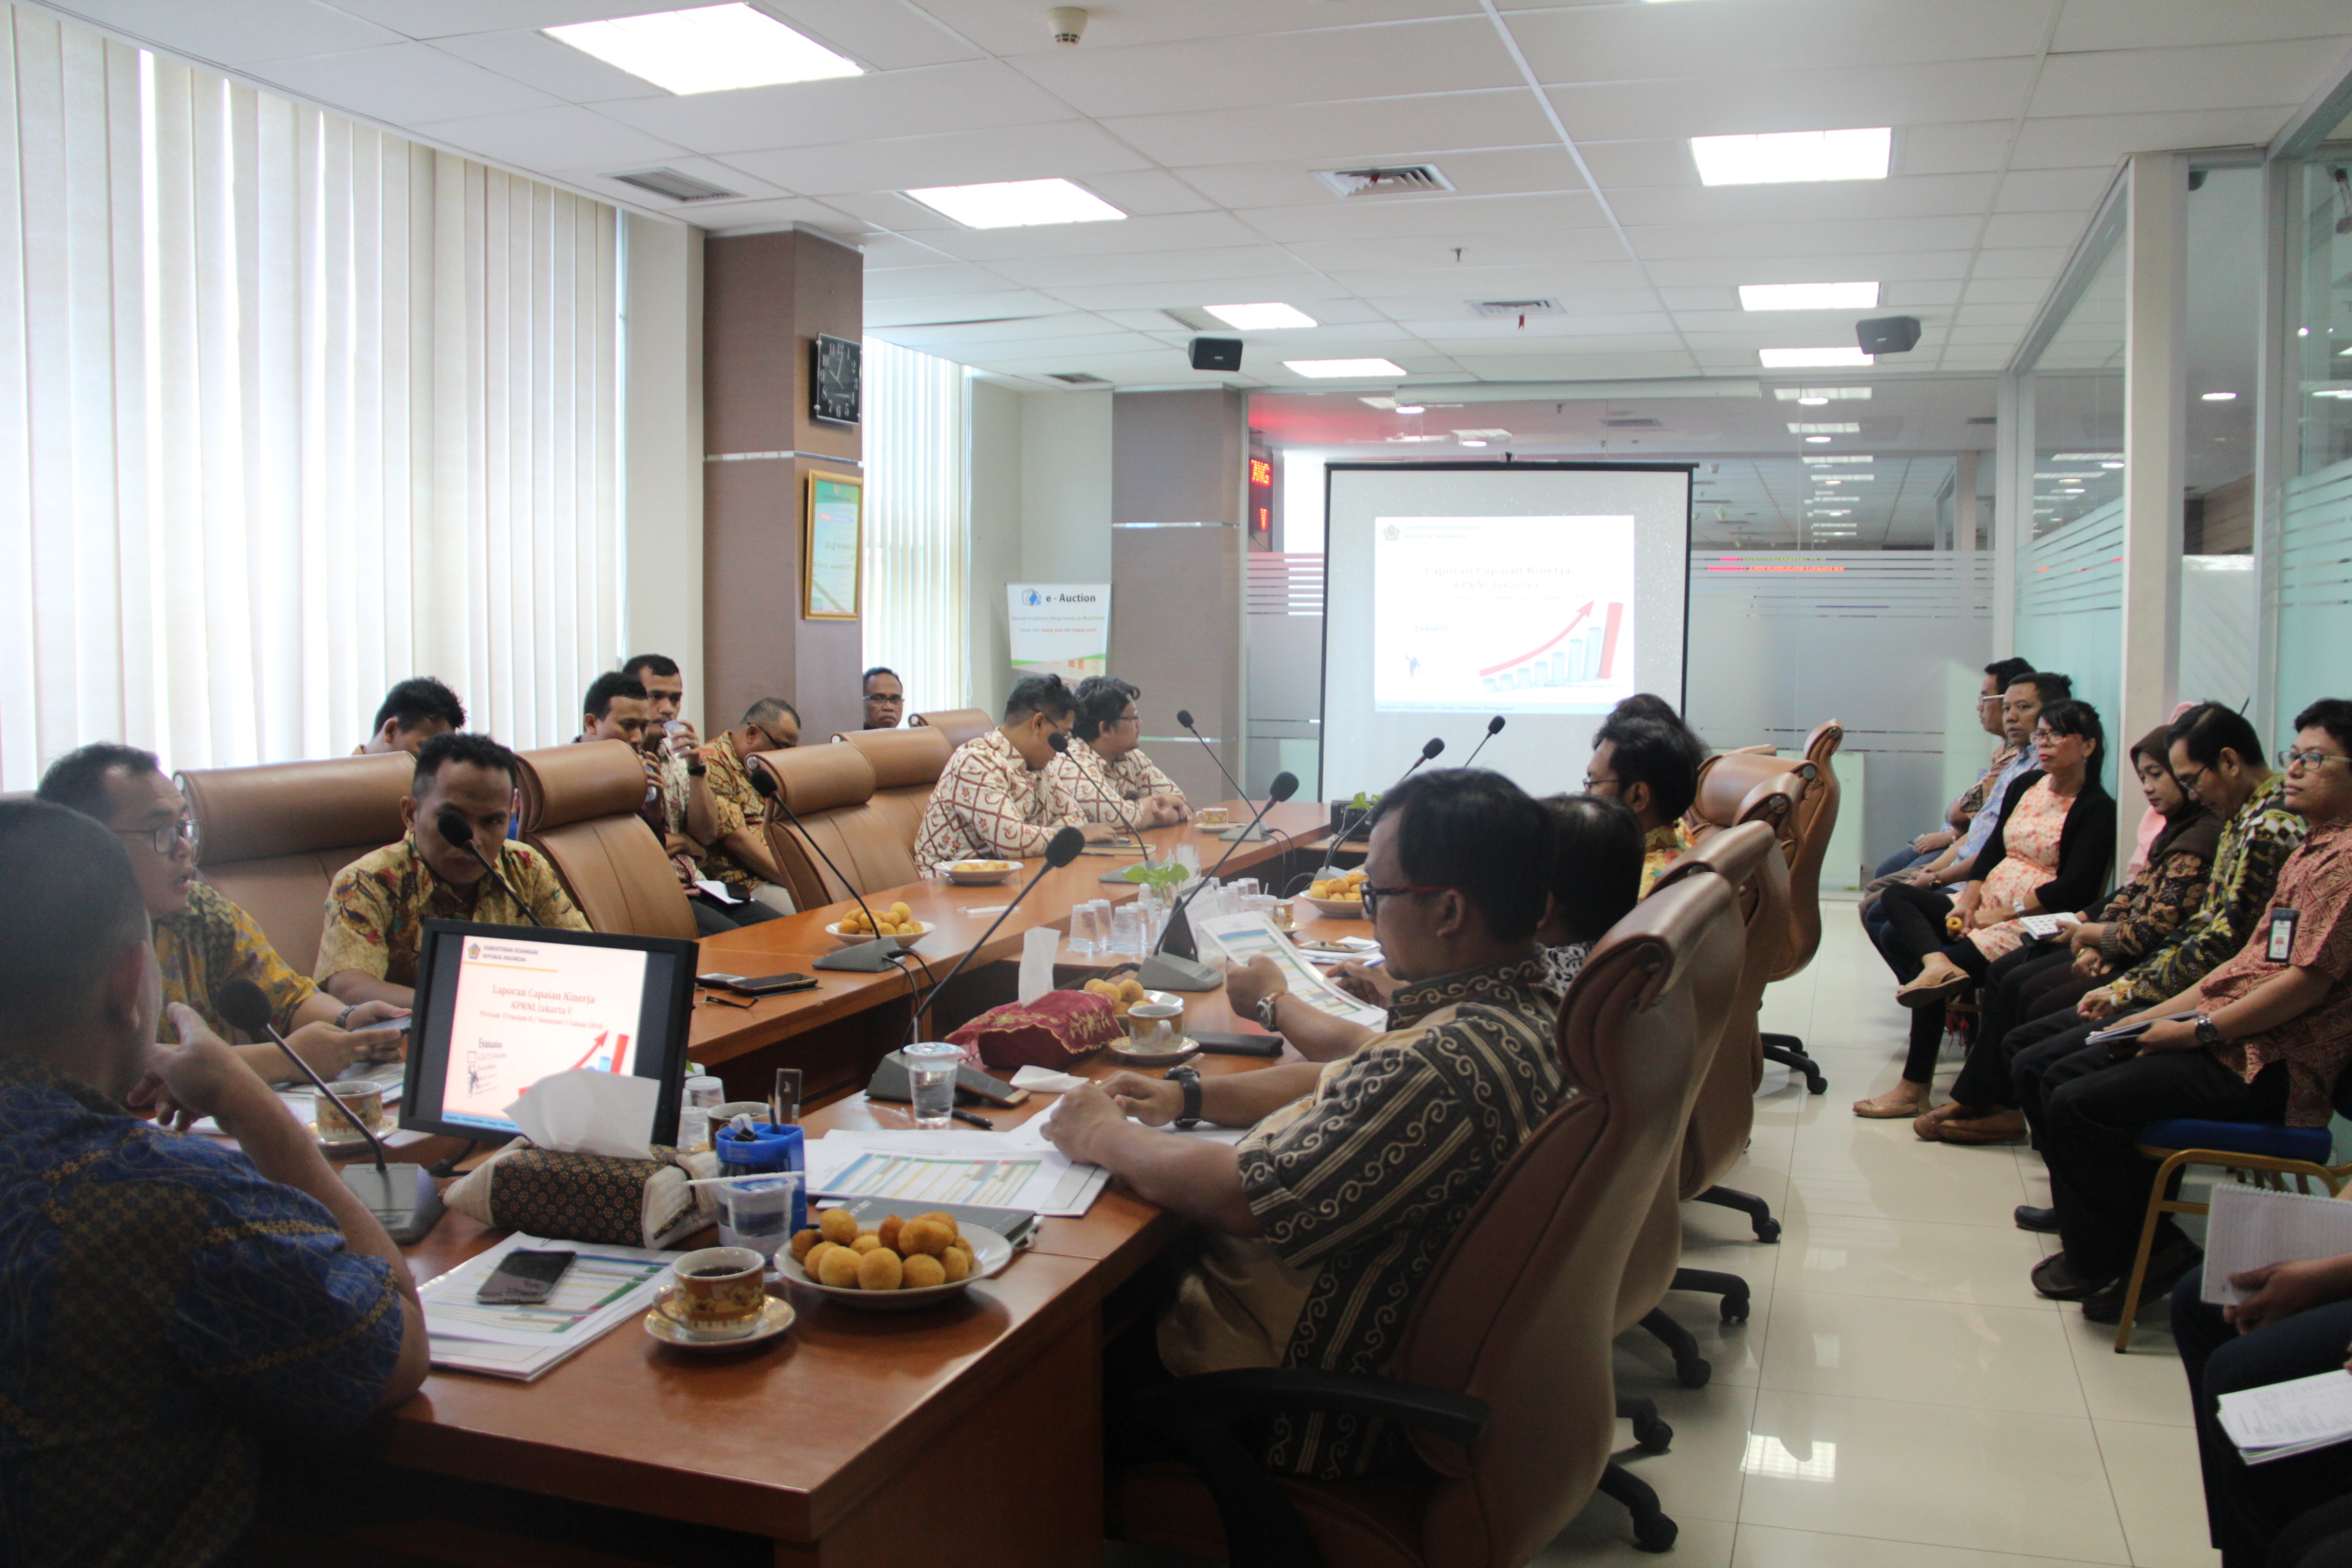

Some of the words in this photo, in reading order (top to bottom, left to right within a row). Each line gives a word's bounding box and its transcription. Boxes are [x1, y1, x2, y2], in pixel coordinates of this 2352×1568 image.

[829, 343, 835, 356] 11
[837, 342, 844, 354] 12
[847, 348, 850, 360] 1
[822, 354, 829, 367] 10
[851, 359, 857, 374] 2
[819, 368, 826, 382] 9
[853, 377, 858, 390] 3
[822, 386, 827, 399] 8
[850, 391, 855, 406] 4
[828, 398, 833, 414] 7
[836, 404, 841, 417] 6
[844, 402, 849, 416] 5
[1426, 565, 1473, 577] Laporan
[1476, 565, 1523, 577] Capaian
[1527, 565, 1570, 576] Kinerja
[1493, 581, 1531, 590] Jakarta
[1534, 581, 1540, 589] V
[1045, 594, 1052, 603] e
[1059, 593, 1096, 603] Auction
[492, 984, 526, 997] Laporan
[528, 988, 562, 1001] Capaian
[564, 991, 595, 1005] Kinerja
[510, 1000, 537, 1012] KPKNL
[537, 1004, 565, 1014] Jakarta
[567, 1006, 573, 1014] V
[479, 1010, 501, 1019] Periode
